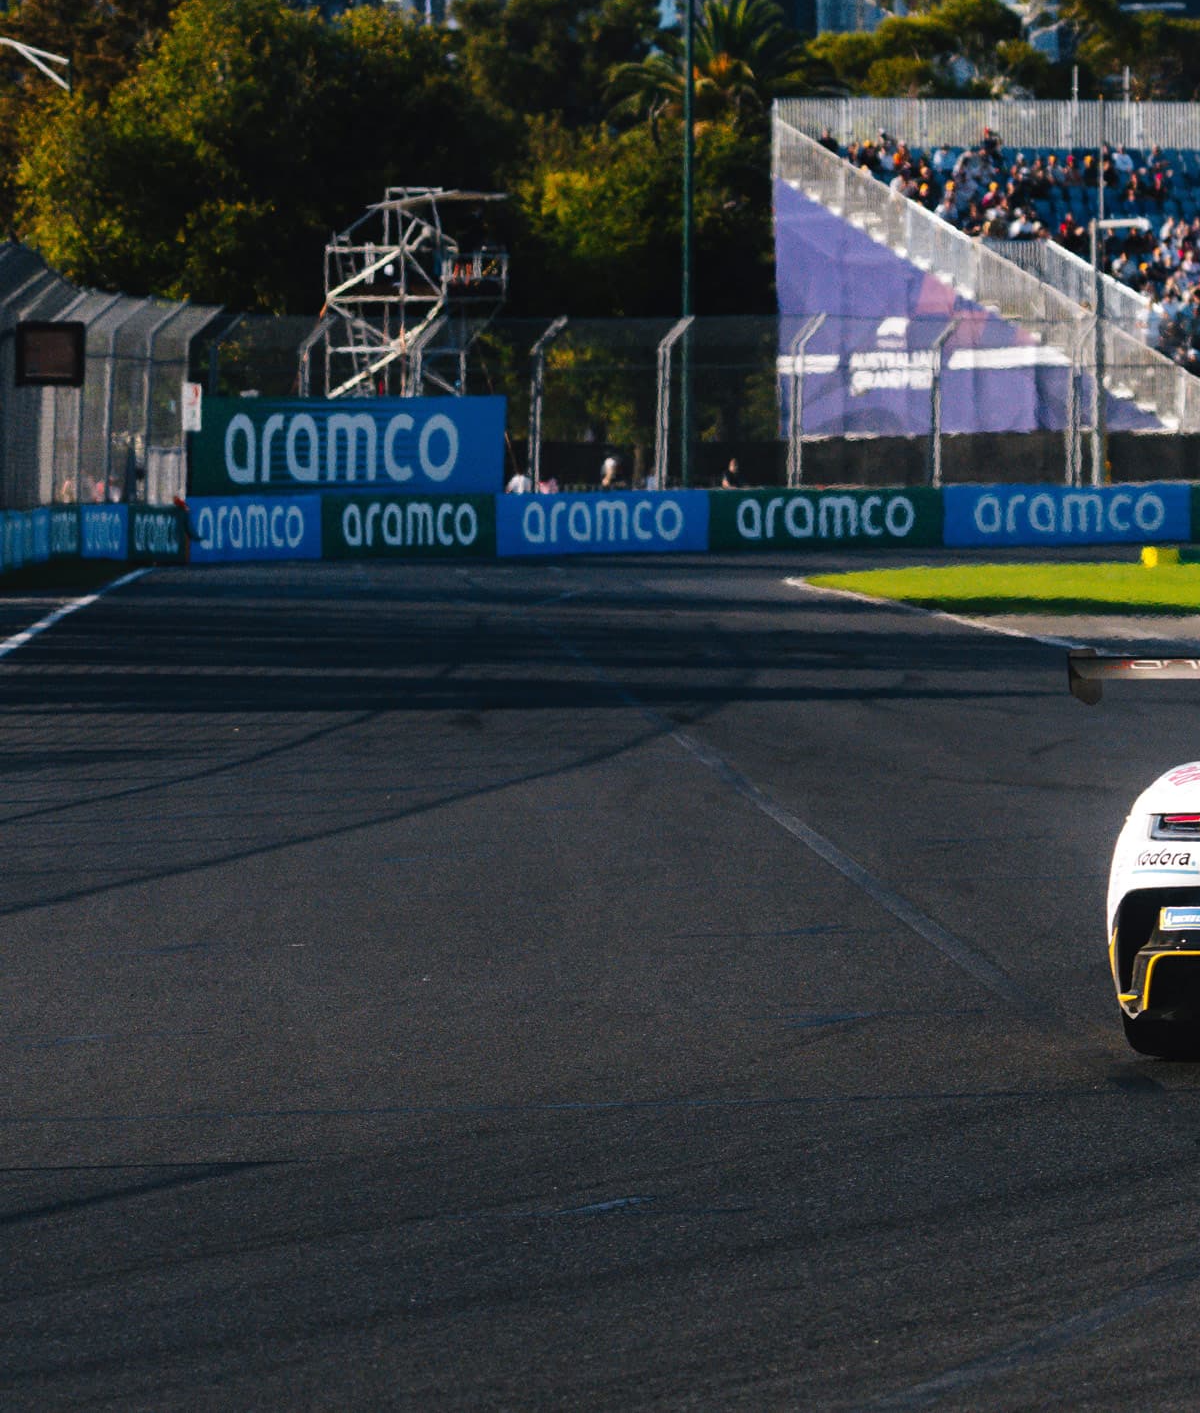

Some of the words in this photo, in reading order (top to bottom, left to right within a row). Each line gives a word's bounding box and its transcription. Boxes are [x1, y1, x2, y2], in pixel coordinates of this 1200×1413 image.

[225, 413, 459, 483] aramco
[199, 504, 304, 549] aramco
[342, 502, 478, 546] aramco
[523, 500, 684, 543] aramco
[737, 496, 915, 538] aramco
[974, 492, 1165, 533] aramco
